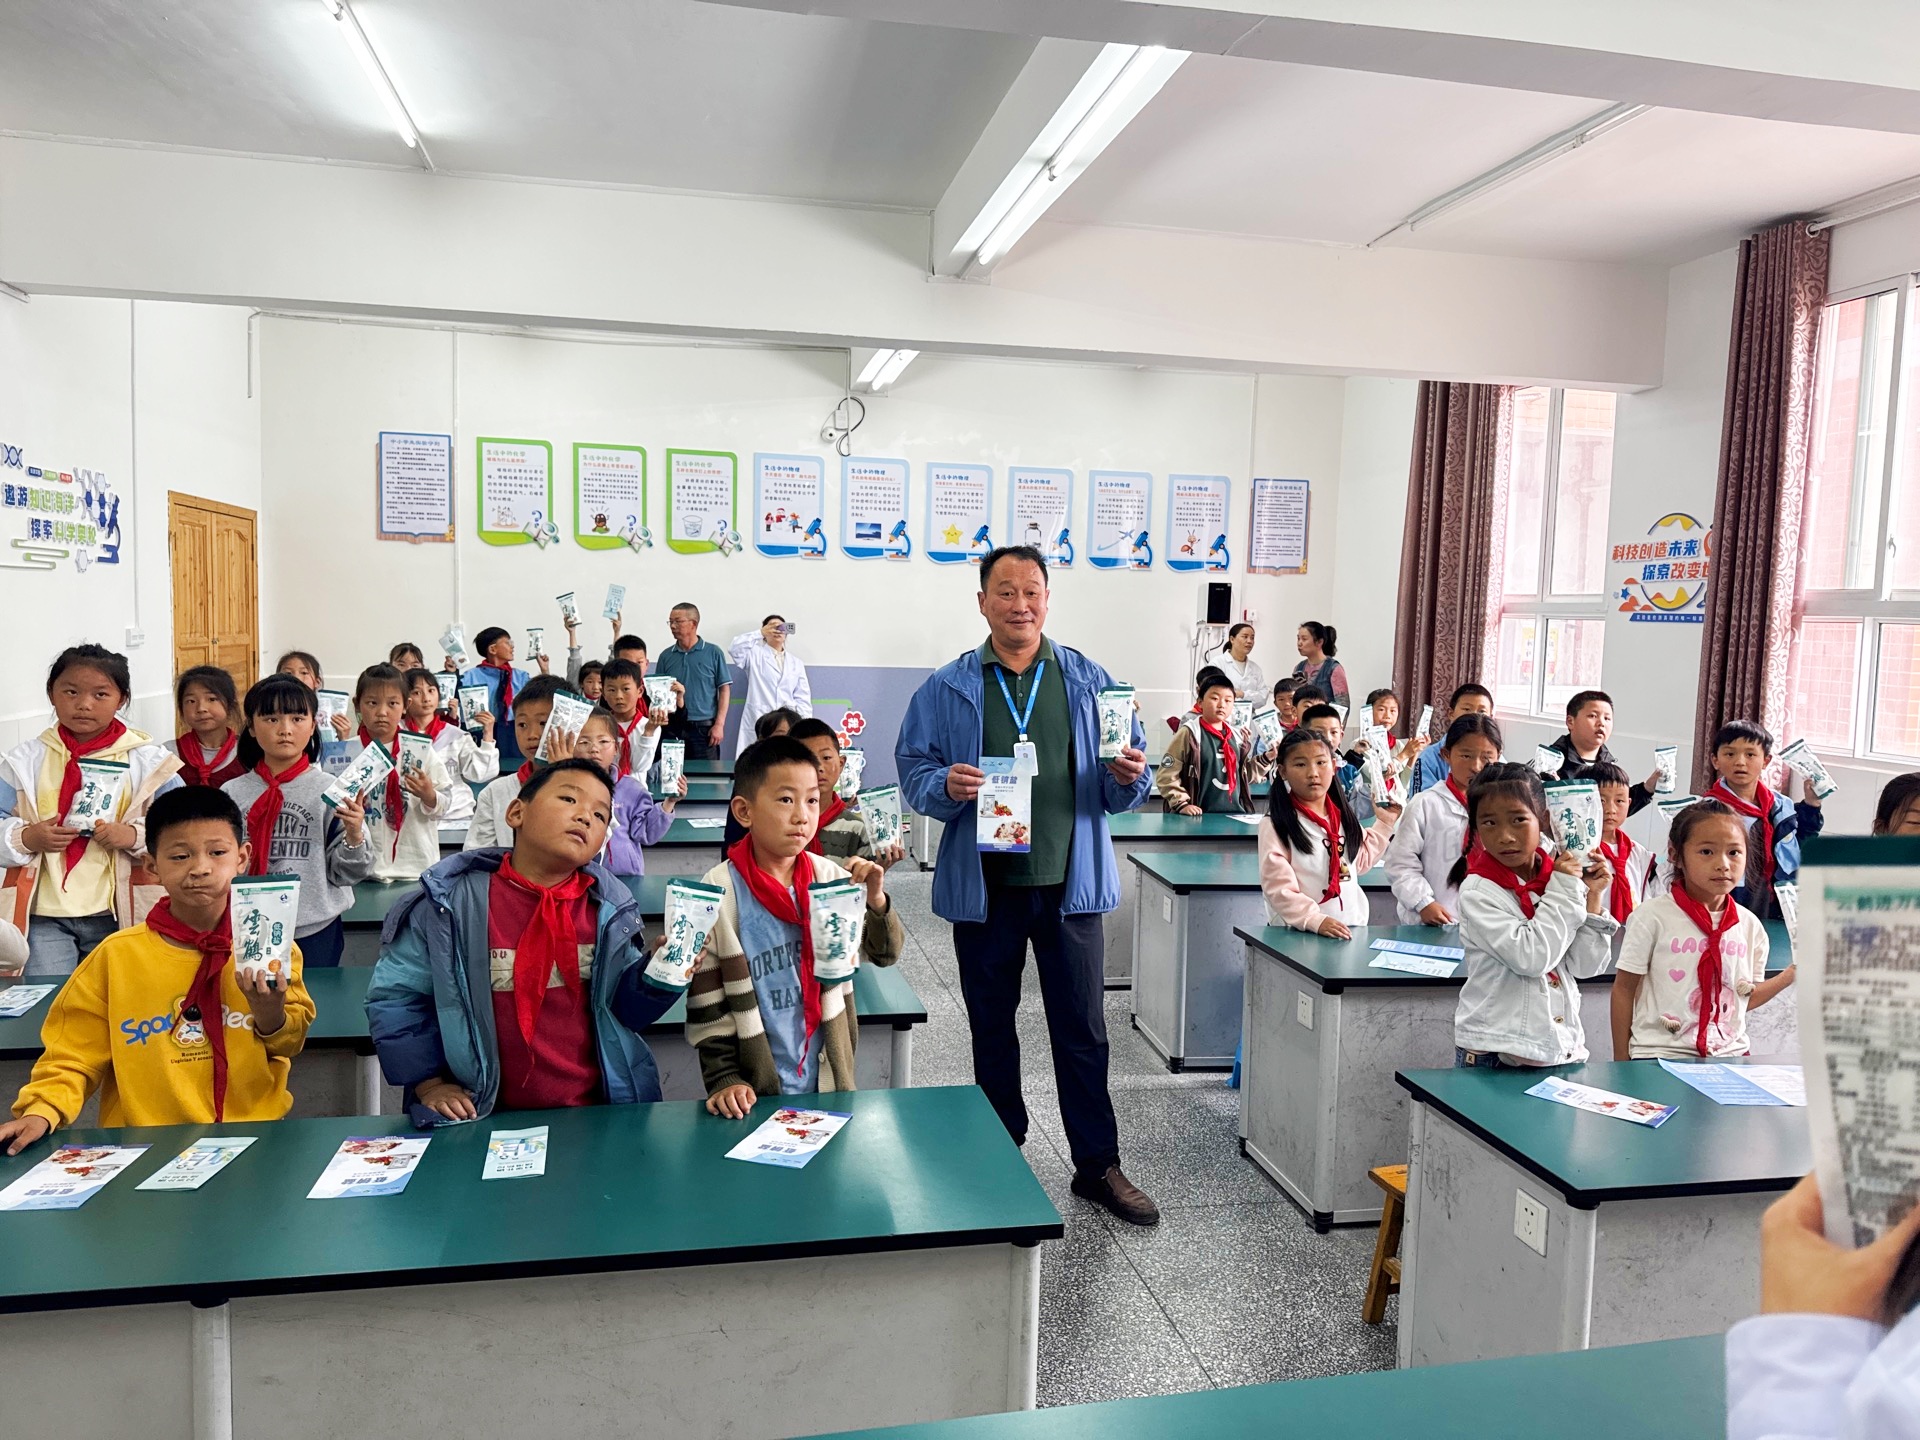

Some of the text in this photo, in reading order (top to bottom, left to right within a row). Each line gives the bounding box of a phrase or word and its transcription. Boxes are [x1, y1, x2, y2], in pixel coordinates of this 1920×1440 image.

[1611, 539, 1699, 561] 科技创造未来
